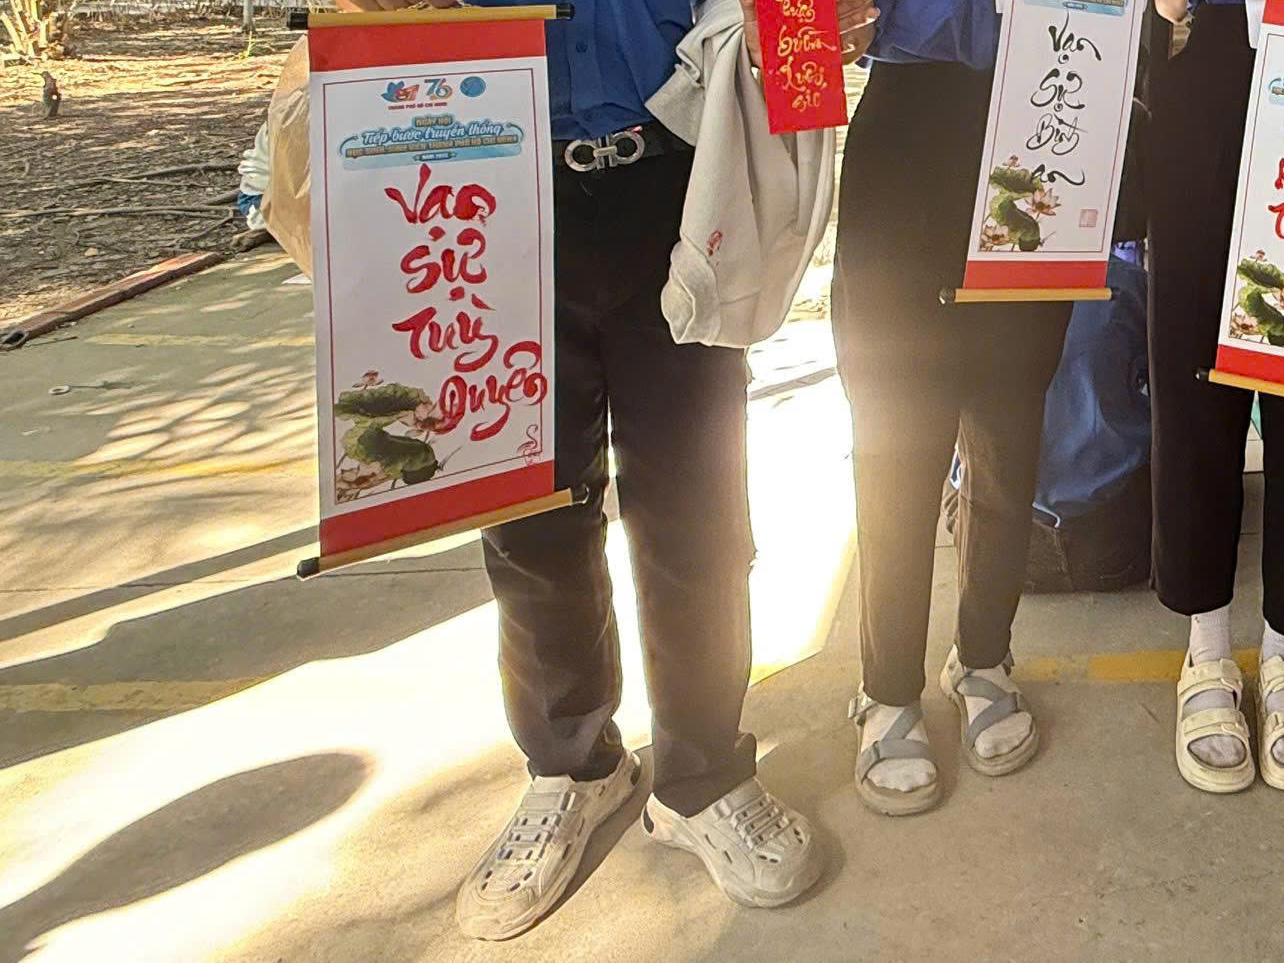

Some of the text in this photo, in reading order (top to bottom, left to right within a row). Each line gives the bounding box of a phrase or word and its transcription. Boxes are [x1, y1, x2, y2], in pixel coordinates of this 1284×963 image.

[1047, 13, 1101, 65] Vạn
[1030, 70, 1085, 113] Sự
[1025, 113, 1088, 156] Bình
[384, 164, 497, 241] Vạn
[400, 227, 488, 301] Sự
